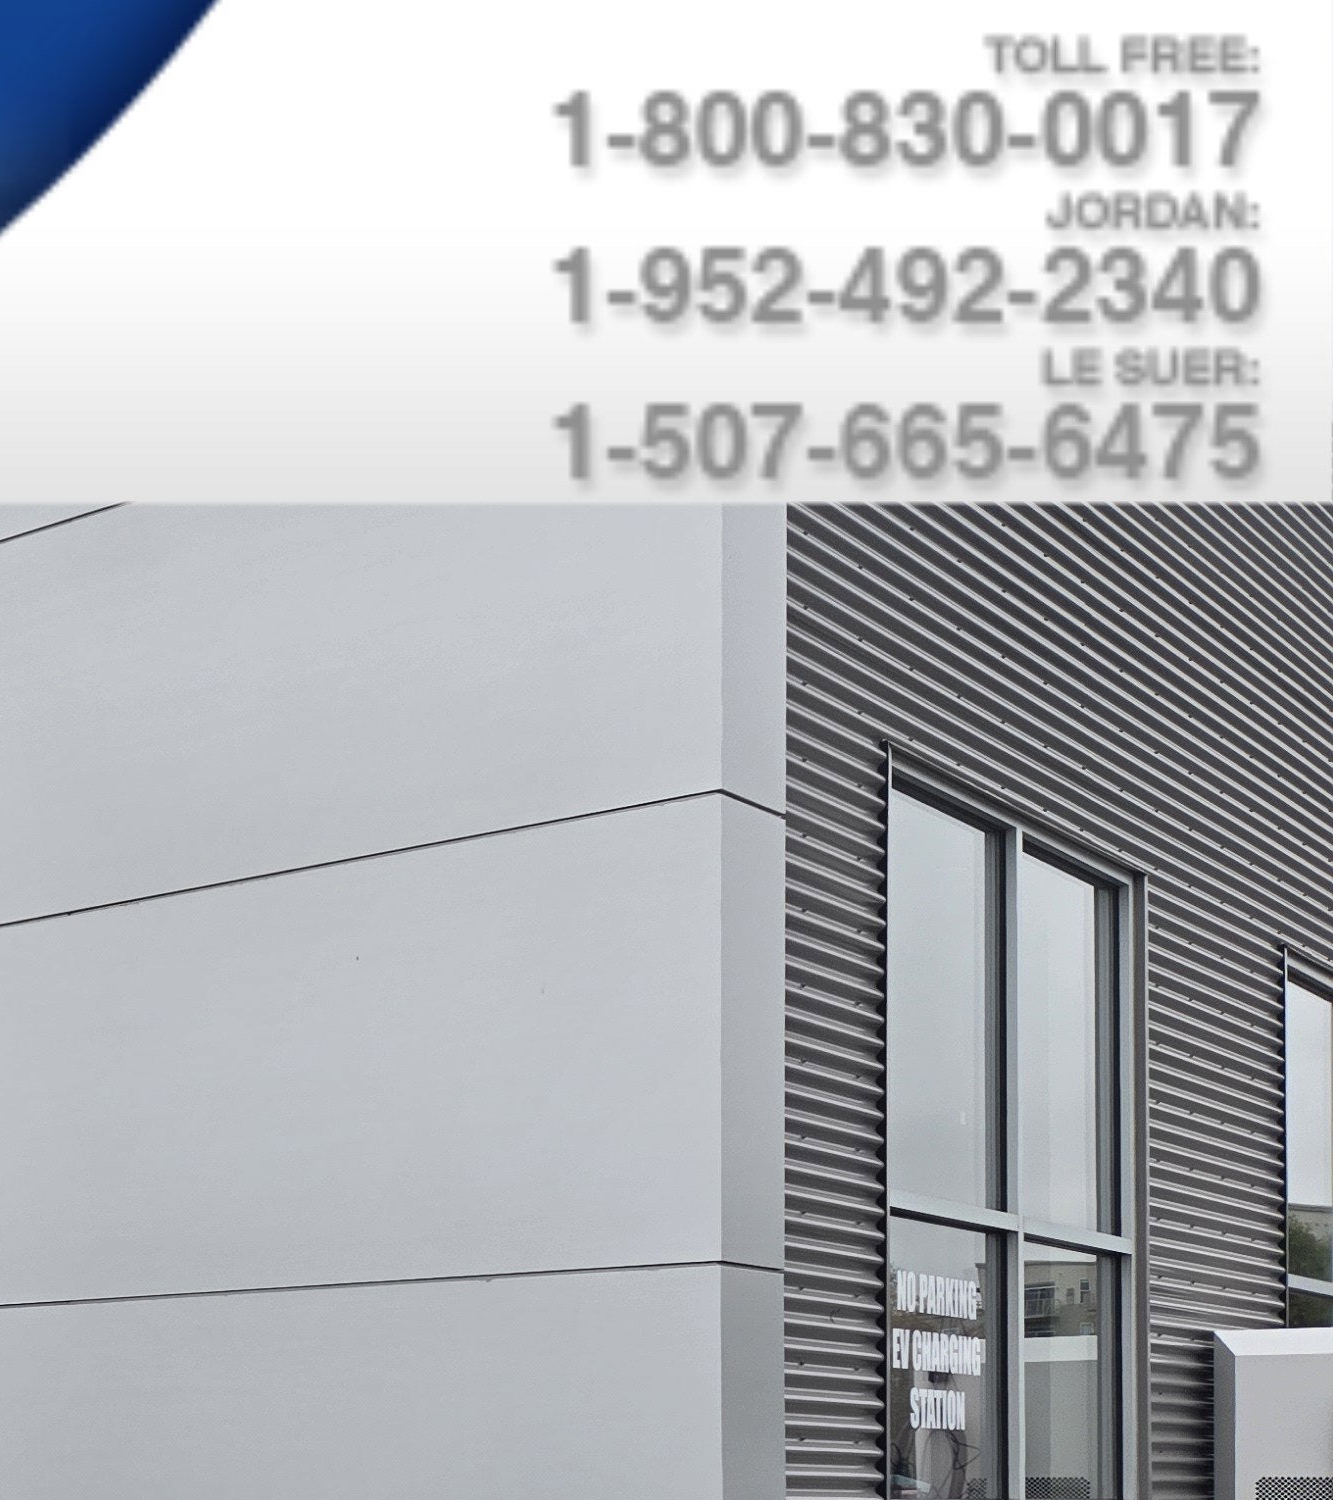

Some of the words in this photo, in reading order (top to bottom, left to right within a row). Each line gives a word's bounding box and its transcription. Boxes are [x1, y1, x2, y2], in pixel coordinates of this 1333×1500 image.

[896, 1270, 916, 1313] NO
[919, 1273, 977, 1320] PARKING
[892, 1328, 910, 1369] EV
[912, 1329, 981, 1376] CHARGING
[910, 1387, 965, 1431] STATION
